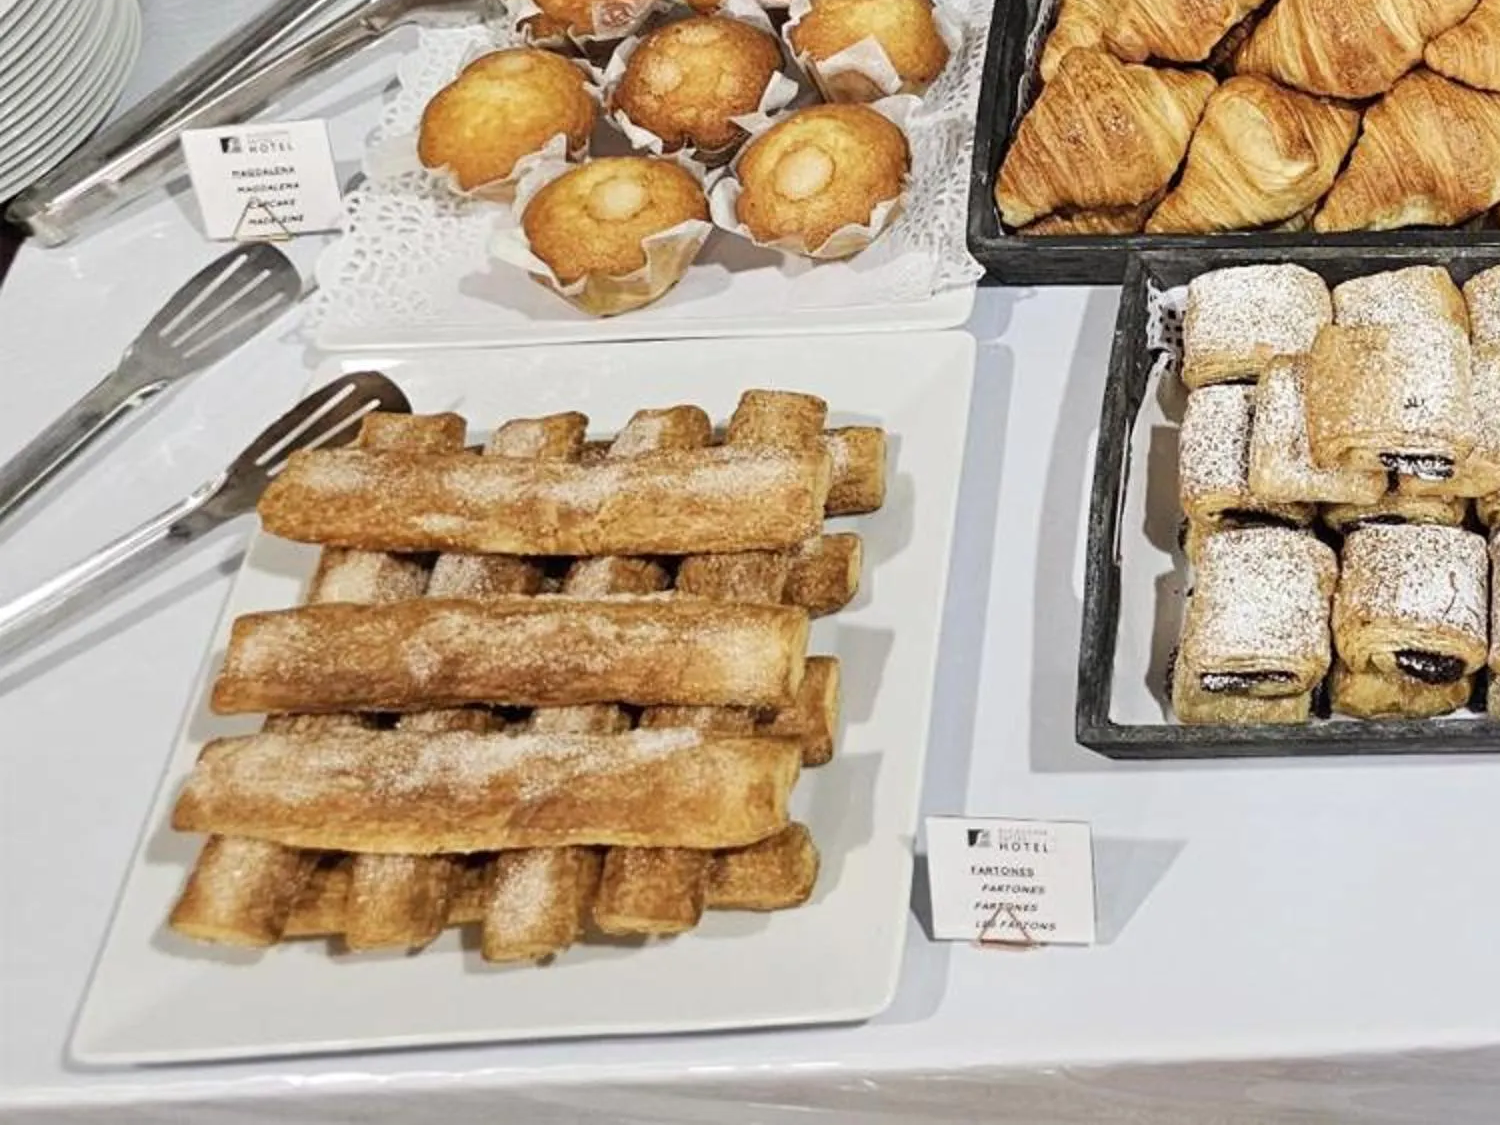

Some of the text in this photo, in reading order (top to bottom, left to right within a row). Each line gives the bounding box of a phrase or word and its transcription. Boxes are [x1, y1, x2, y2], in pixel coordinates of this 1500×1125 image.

[249, 141, 294, 154] HOTEL
[231, 166, 295, 178] MAGDALENA
[999, 842, 1049, 854] HOTEL
[971, 865, 1035, 878] FARTONES
[981, 883, 1046, 895] FARTONES
